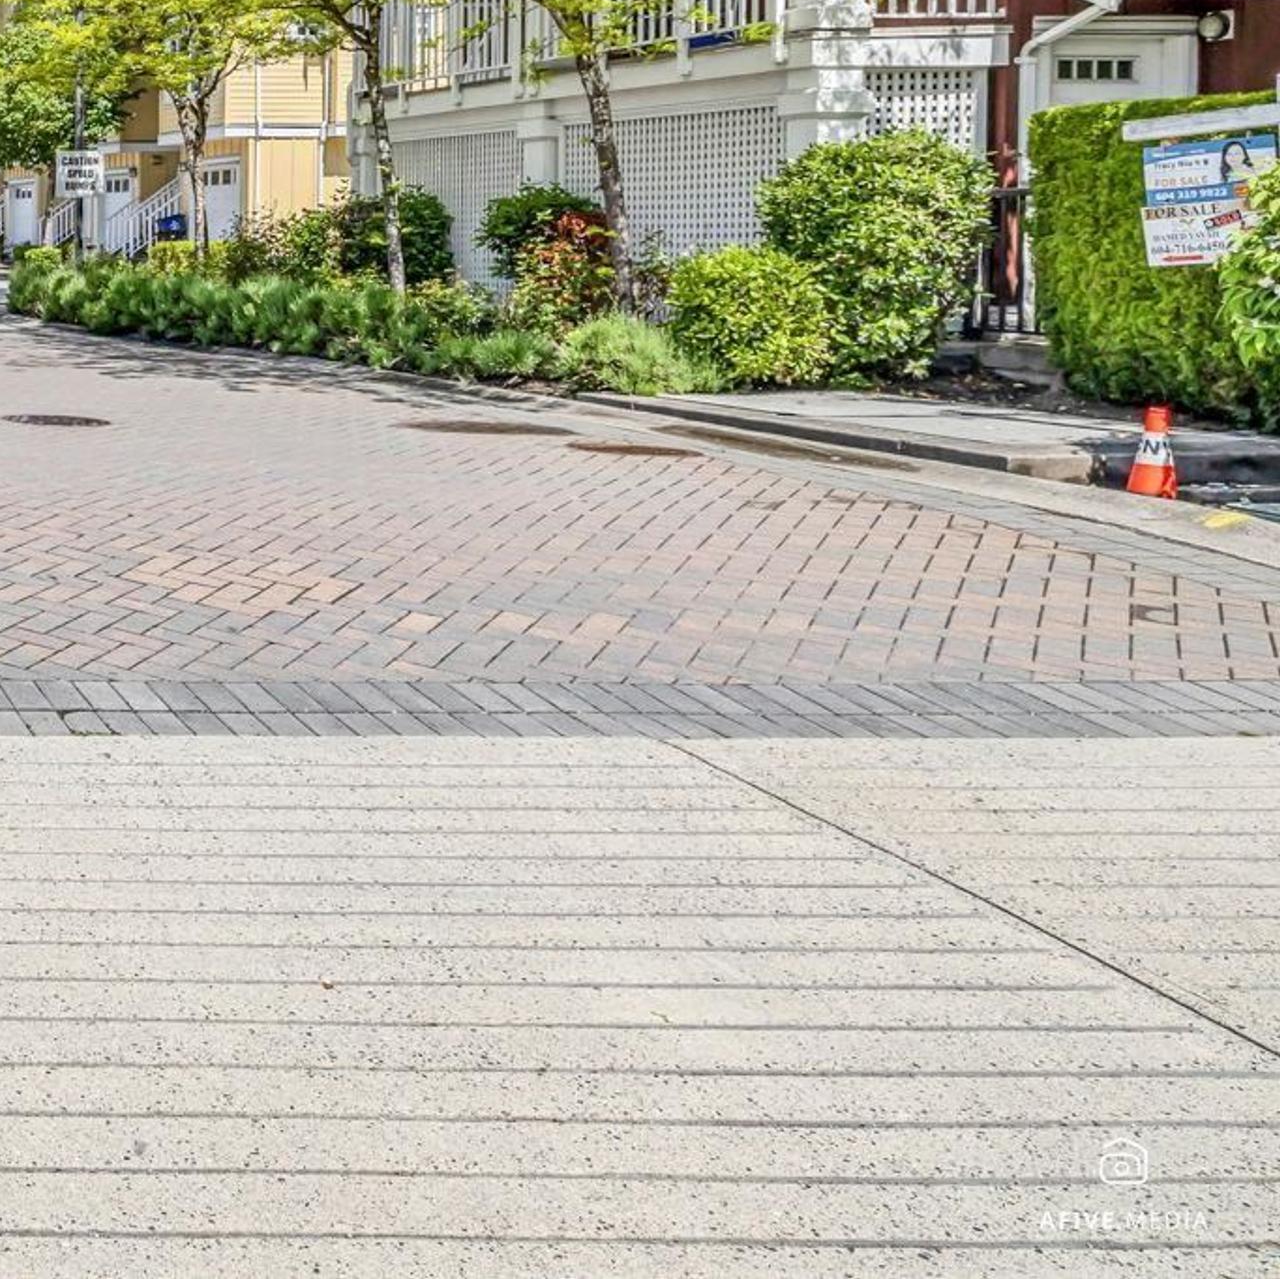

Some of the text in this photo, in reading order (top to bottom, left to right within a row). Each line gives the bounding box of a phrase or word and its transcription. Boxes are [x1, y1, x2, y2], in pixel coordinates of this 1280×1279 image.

[1154, 176, 1208, 187] FOR SALE
[1156, 192, 1175, 200] 604
[1145, 203, 1220, 220] FOR SALE
